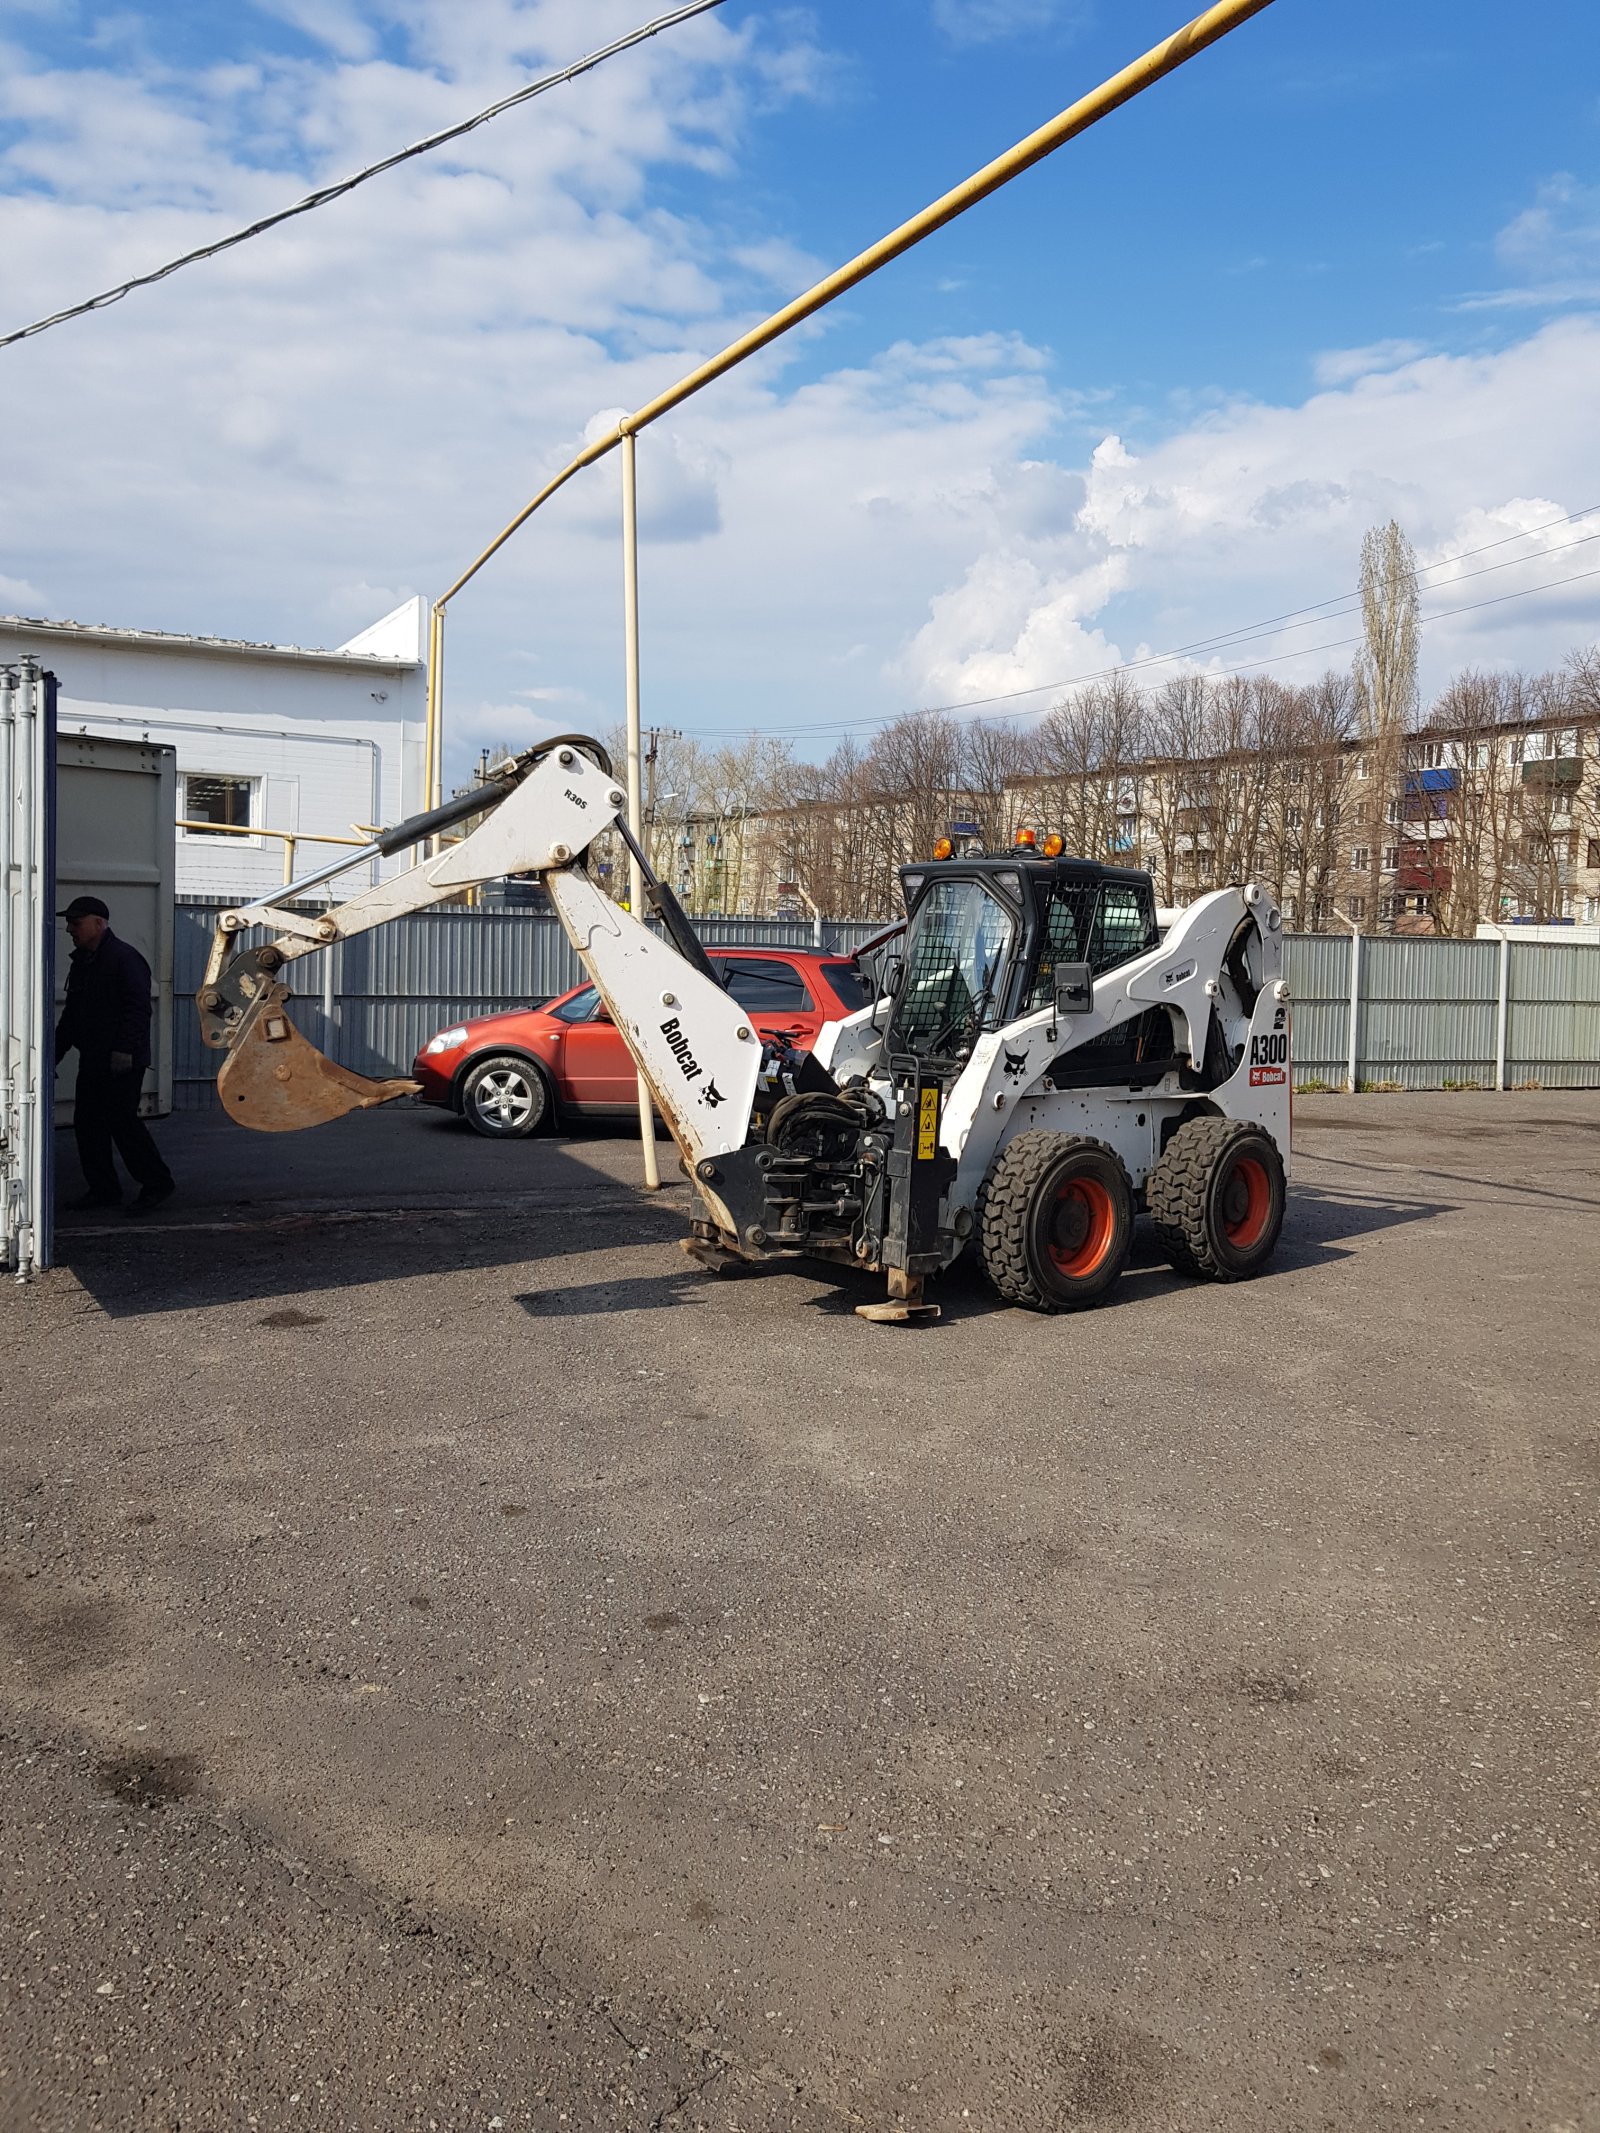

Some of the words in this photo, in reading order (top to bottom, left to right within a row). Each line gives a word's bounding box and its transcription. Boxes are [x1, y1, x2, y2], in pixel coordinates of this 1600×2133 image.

[563, 789, 588, 810] R30S
[660, 1017, 703, 1082] Bobcat
[1249, 1034, 1288, 1066] A300
[1262, 1071, 1283, 1083] Bobcat
